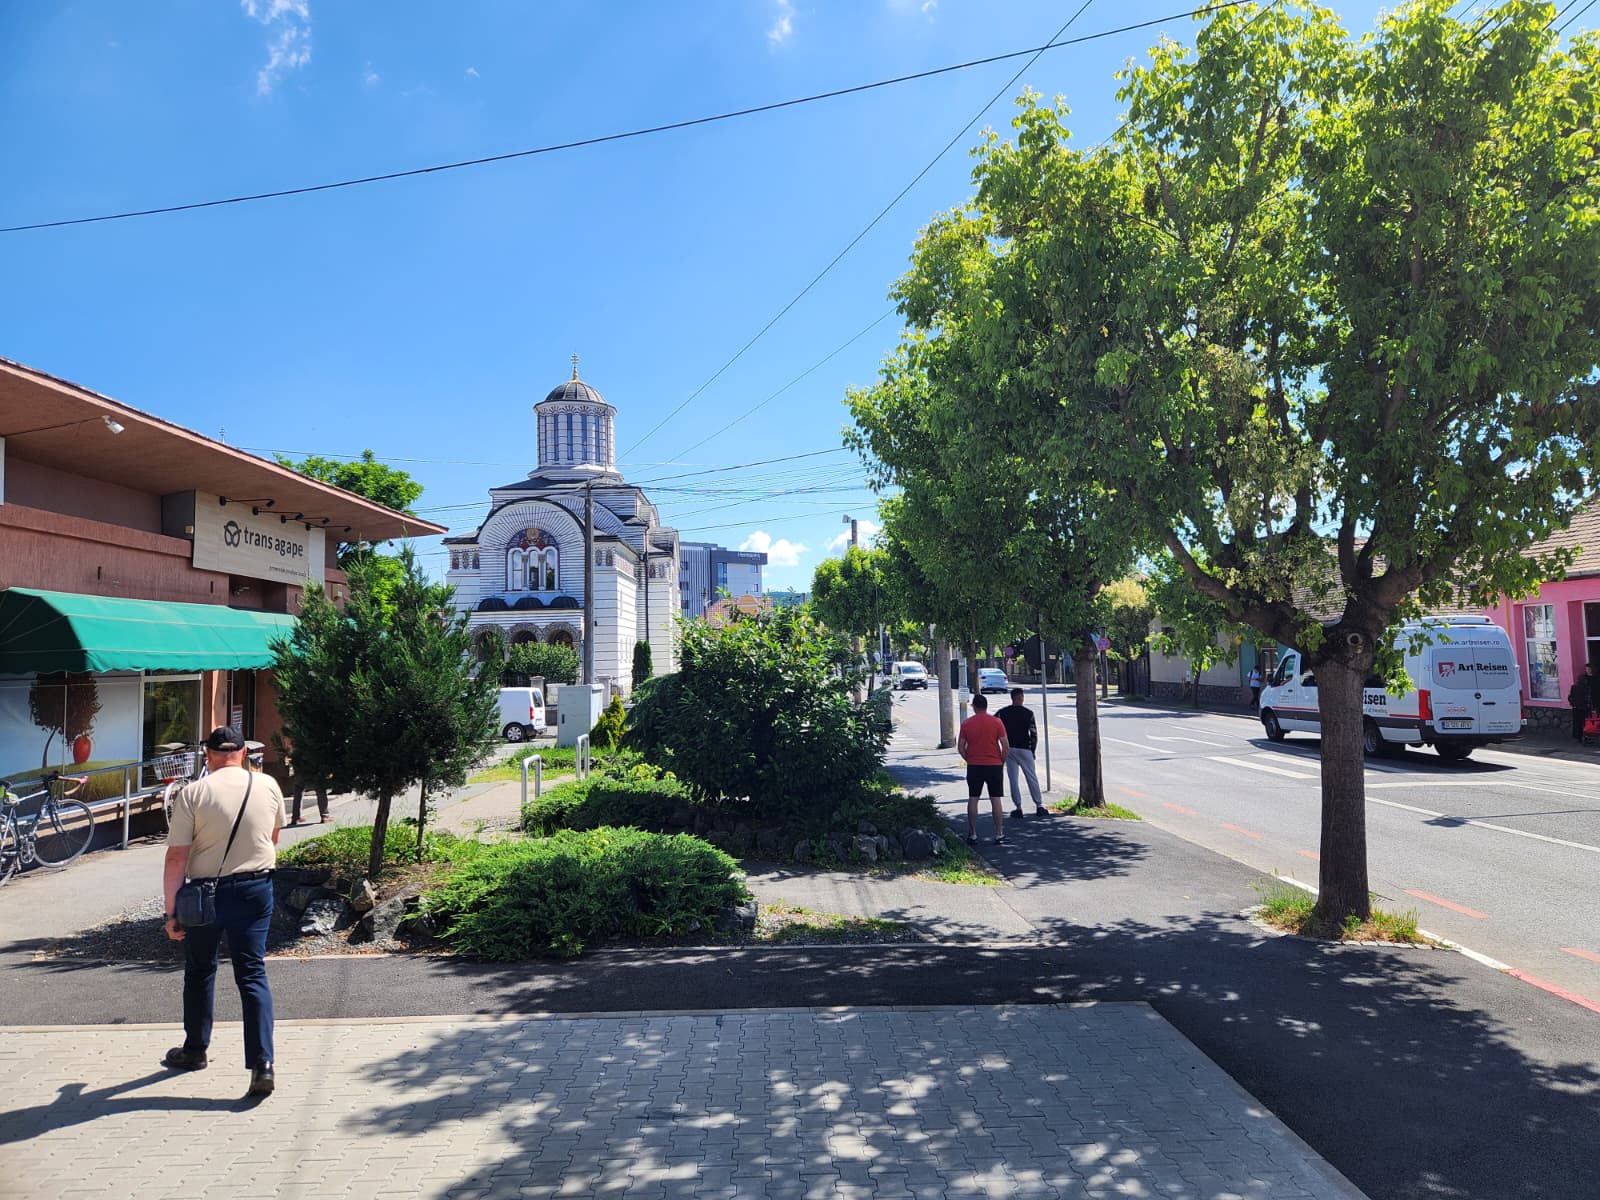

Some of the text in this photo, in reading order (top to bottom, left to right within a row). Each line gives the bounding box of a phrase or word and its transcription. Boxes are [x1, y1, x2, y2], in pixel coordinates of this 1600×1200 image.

[244, 526, 304, 558] trans agape
[1458, 662, 1508, 671] Art Reisen
[1363, 690, 1386, 705] isen
